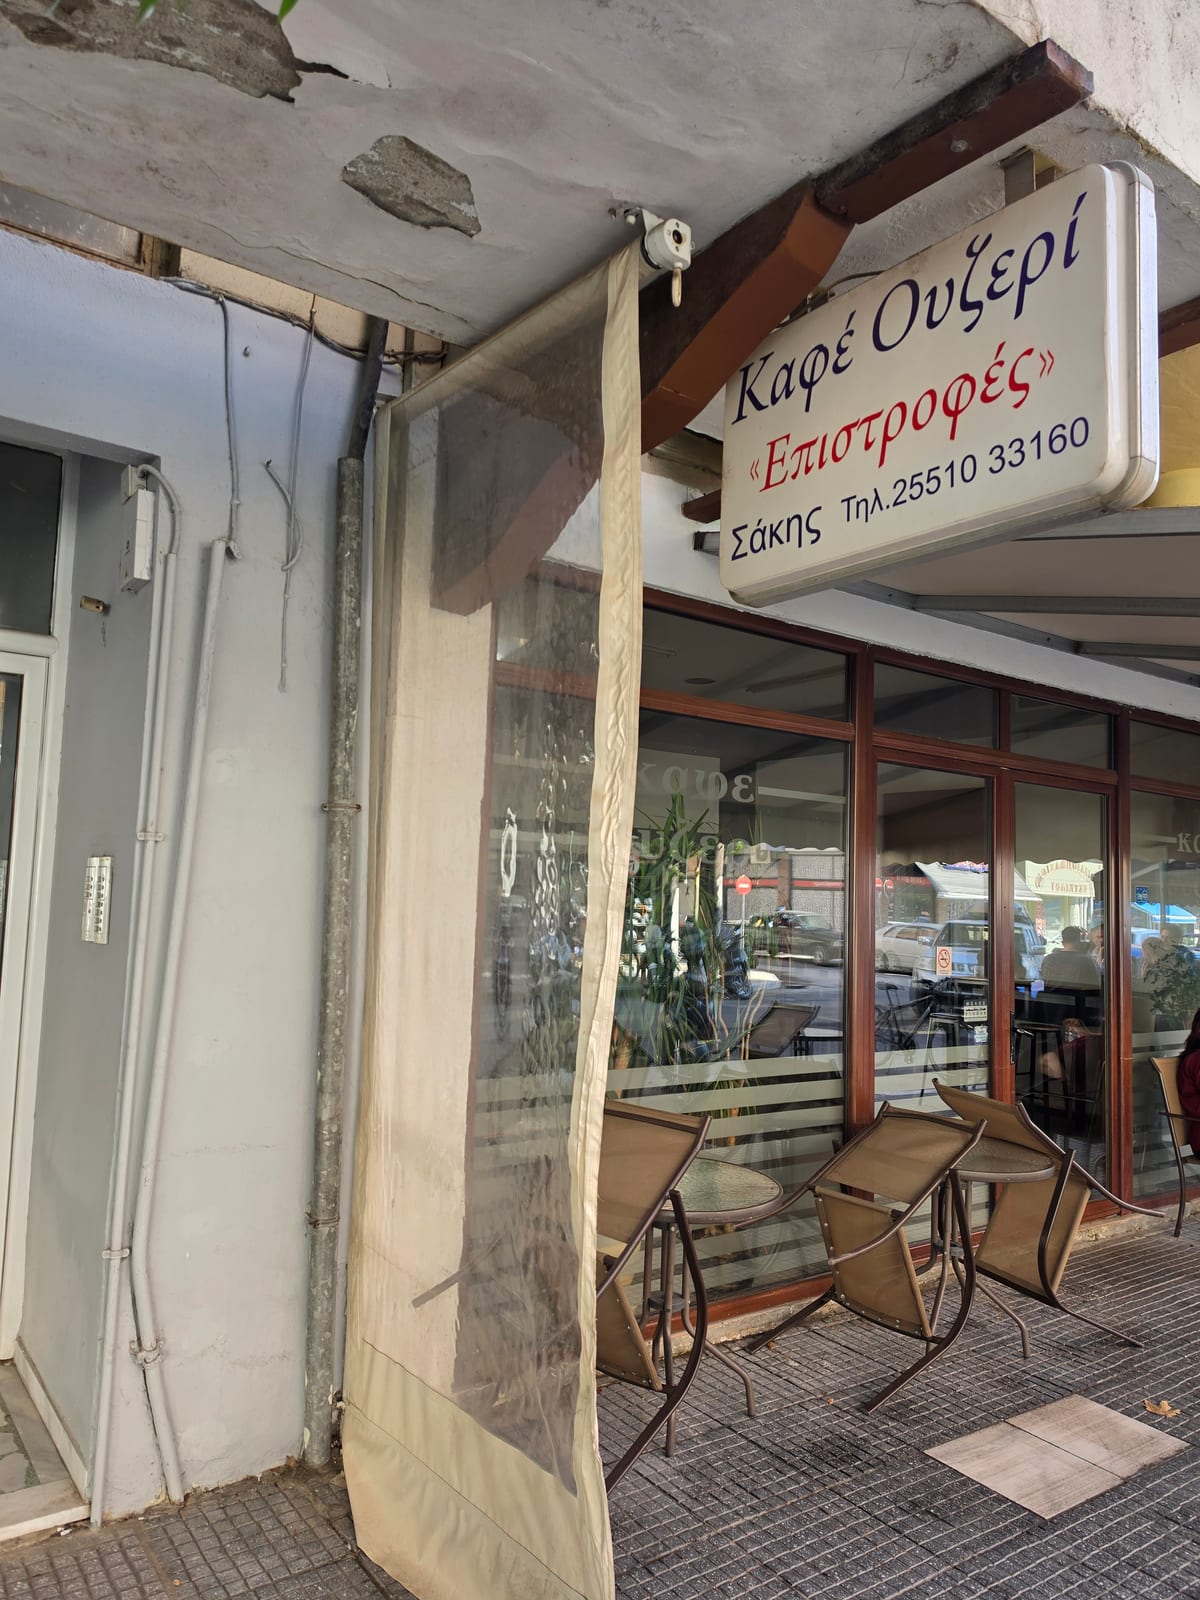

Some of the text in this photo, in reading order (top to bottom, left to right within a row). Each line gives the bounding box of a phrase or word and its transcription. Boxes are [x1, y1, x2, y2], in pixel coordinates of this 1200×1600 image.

[732, 191, 1087, 425] Καφέ Ουζερί
[731, 416, 1090, 561] Σάκης Τηλ.25510 33160
